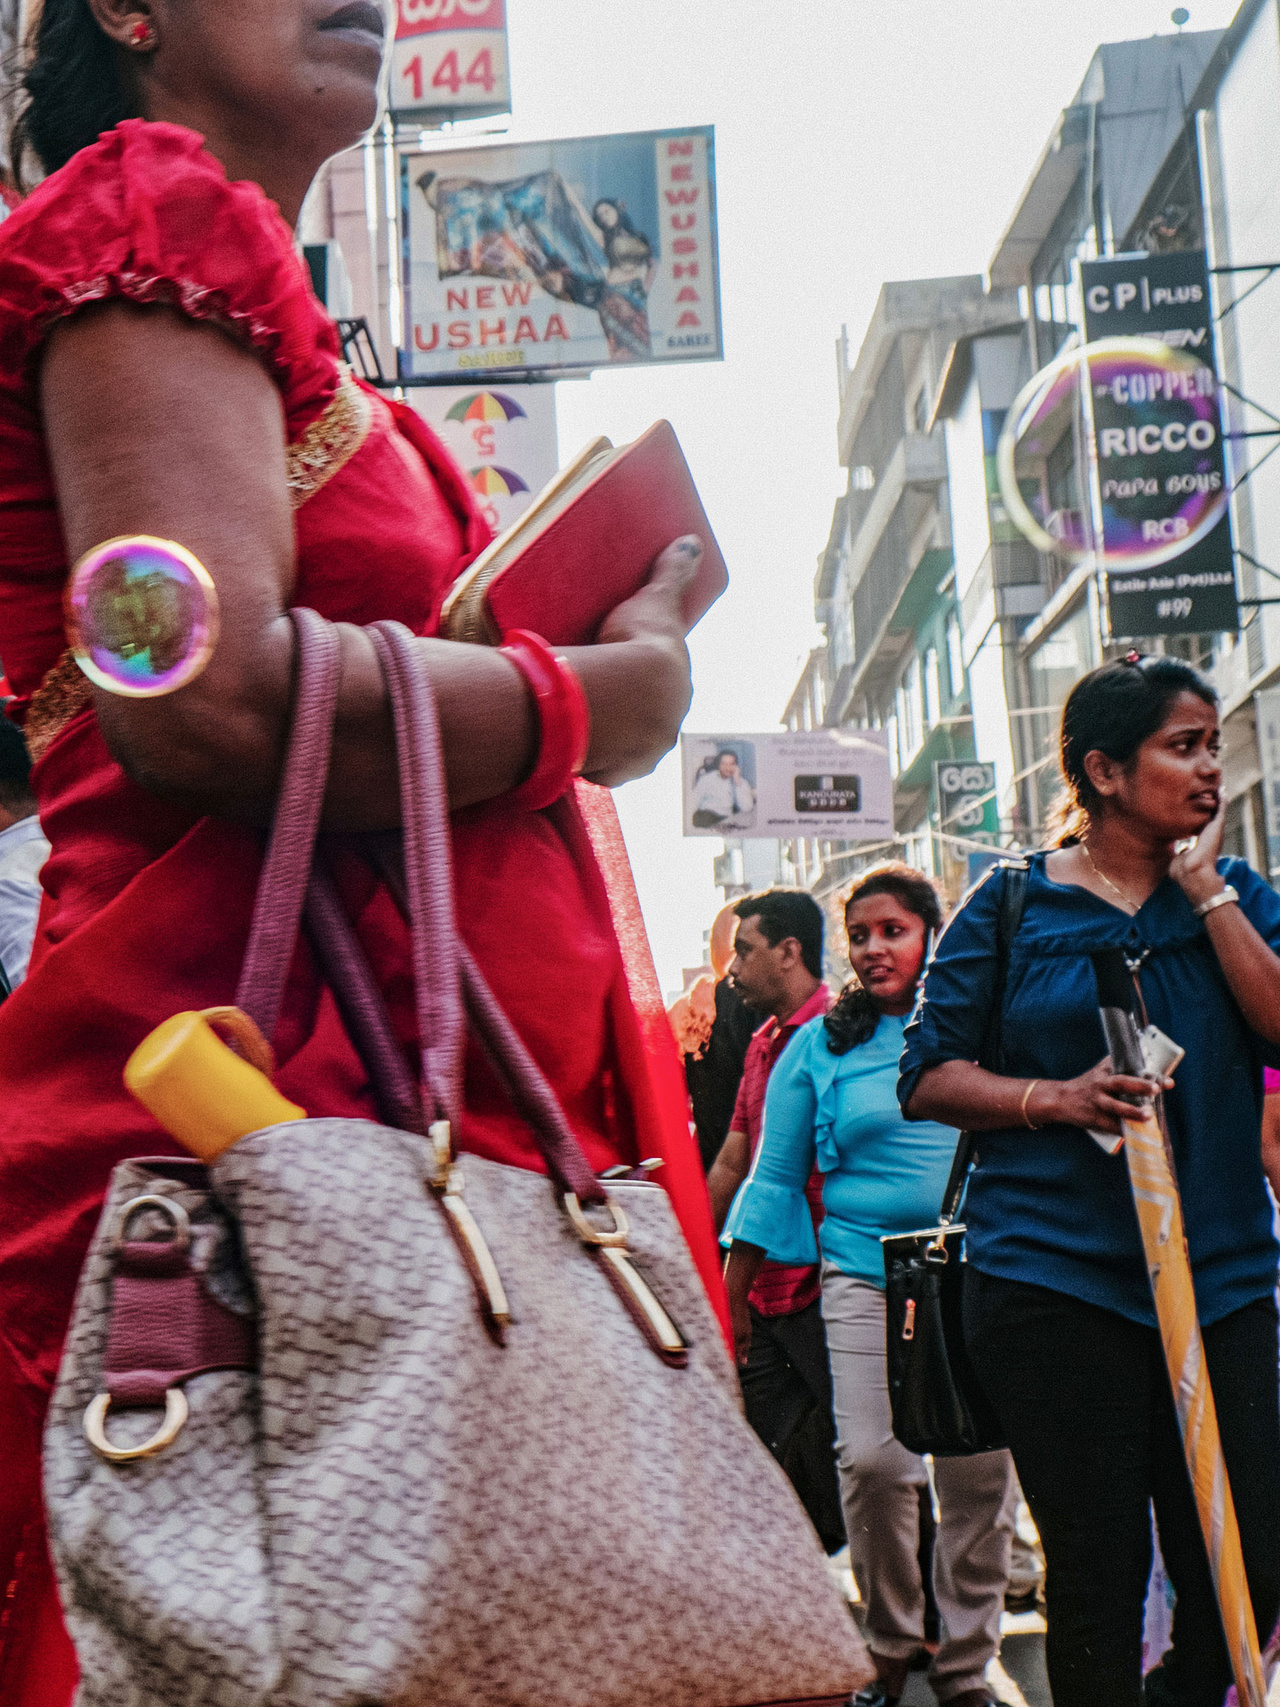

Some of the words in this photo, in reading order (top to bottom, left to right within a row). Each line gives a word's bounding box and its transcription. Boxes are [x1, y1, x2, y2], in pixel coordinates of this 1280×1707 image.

[403, 48, 496, 100] 144
[446, 281, 532, 311] NEW
[1152, 285, 1203, 307] PLUS
[414, 312, 570, 352] USHAA
[1100, 420, 1216, 458] RICCO
[1157, 597, 1193, 619] #99
